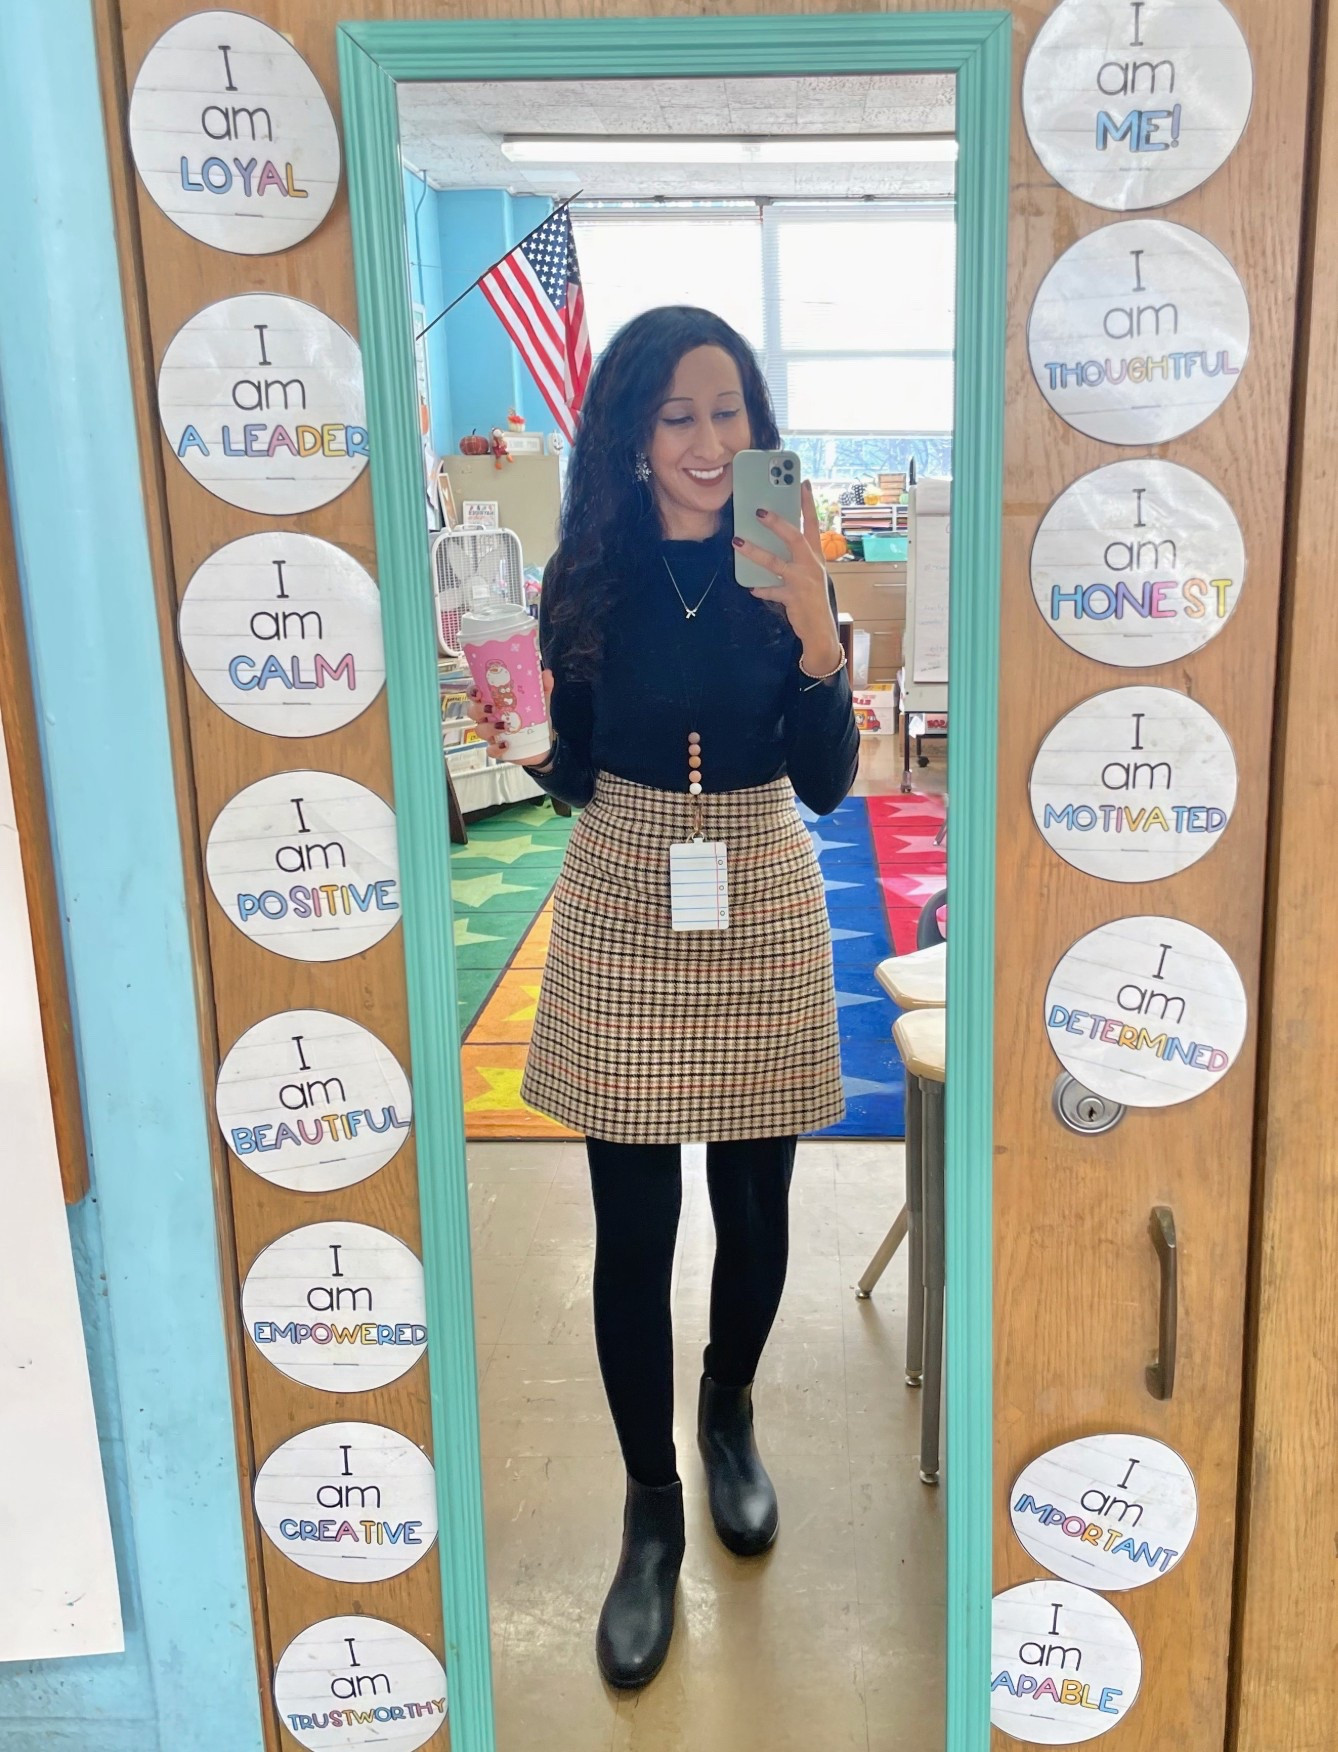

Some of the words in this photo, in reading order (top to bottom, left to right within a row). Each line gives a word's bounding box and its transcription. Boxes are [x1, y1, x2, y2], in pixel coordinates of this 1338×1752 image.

[1129, 1, 1145, 47] I
[218, 45, 238, 91] I
[1096, 59, 1176, 96] am
[201, 104, 273, 142] am
[1095, 103, 1182, 153] ME!
[180, 155, 308, 199] LOYAL
[1129, 250, 1146, 293] I
[1103, 302, 1178, 340] am
[253, 324, 272, 366] I
[1044, 350, 1240, 390] THOUGHTFUL
[232, 378, 306, 411] am
[177, 424, 210, 458] A
[221, 423, 370, 458] LEADER
[1132, 488, 1147, 527] I
[1103, 539, 1176, 571] am
[272, 560, 289, 599] I
[1050, 577, 1233, 621] HONEST
[249, 611, 323, 641] am
[228, 652, 357, 691] CALM
[1131, 713, 1145, 750] I
[1101, 762, 1172, 791] am
[290, 798, 311, 833] I
[1043, 803, 1226, 834] MOTIVATED
[275, 841, 346, 873] am
[236, 880, 399, 921] POSITIVE
[1152, 943, 1173, 980] I
[1116, 983, 1186, 1025] am
[291, 1035, 311, 1071] I
[1047, 1004, 1229, 1073] DETERMINED
[278, 1076, 346, 1110] am
[231, 1105, 411, 1156] BEAUTIFUL
[328, 1244, 344, 1277] I
[306, 1286, 373, 1312] am
[253, 1321, 428, 1346] EMPOWERED
[339, 1445, 353, 1476] I
[1117, 1458, 1140, 1490] I
[316, 1485, 381, 1508] am
[1080, 1489, 1144, 1528] am
[279, 1518, 422, 1545] CREATIVE
[1014, 1493, 1178, 1573] IMPORTANT
[1048, 1603, 1063, 1636] I
[344, 1637, 361, 1667] I
[1018, 1642, 1082, 1672] am
[330, 1673, 391, 1699] am
[990, 1670, 1123, 1714] APABLE
[287, 1697, 446, 1731] TRUSTWORTHY
